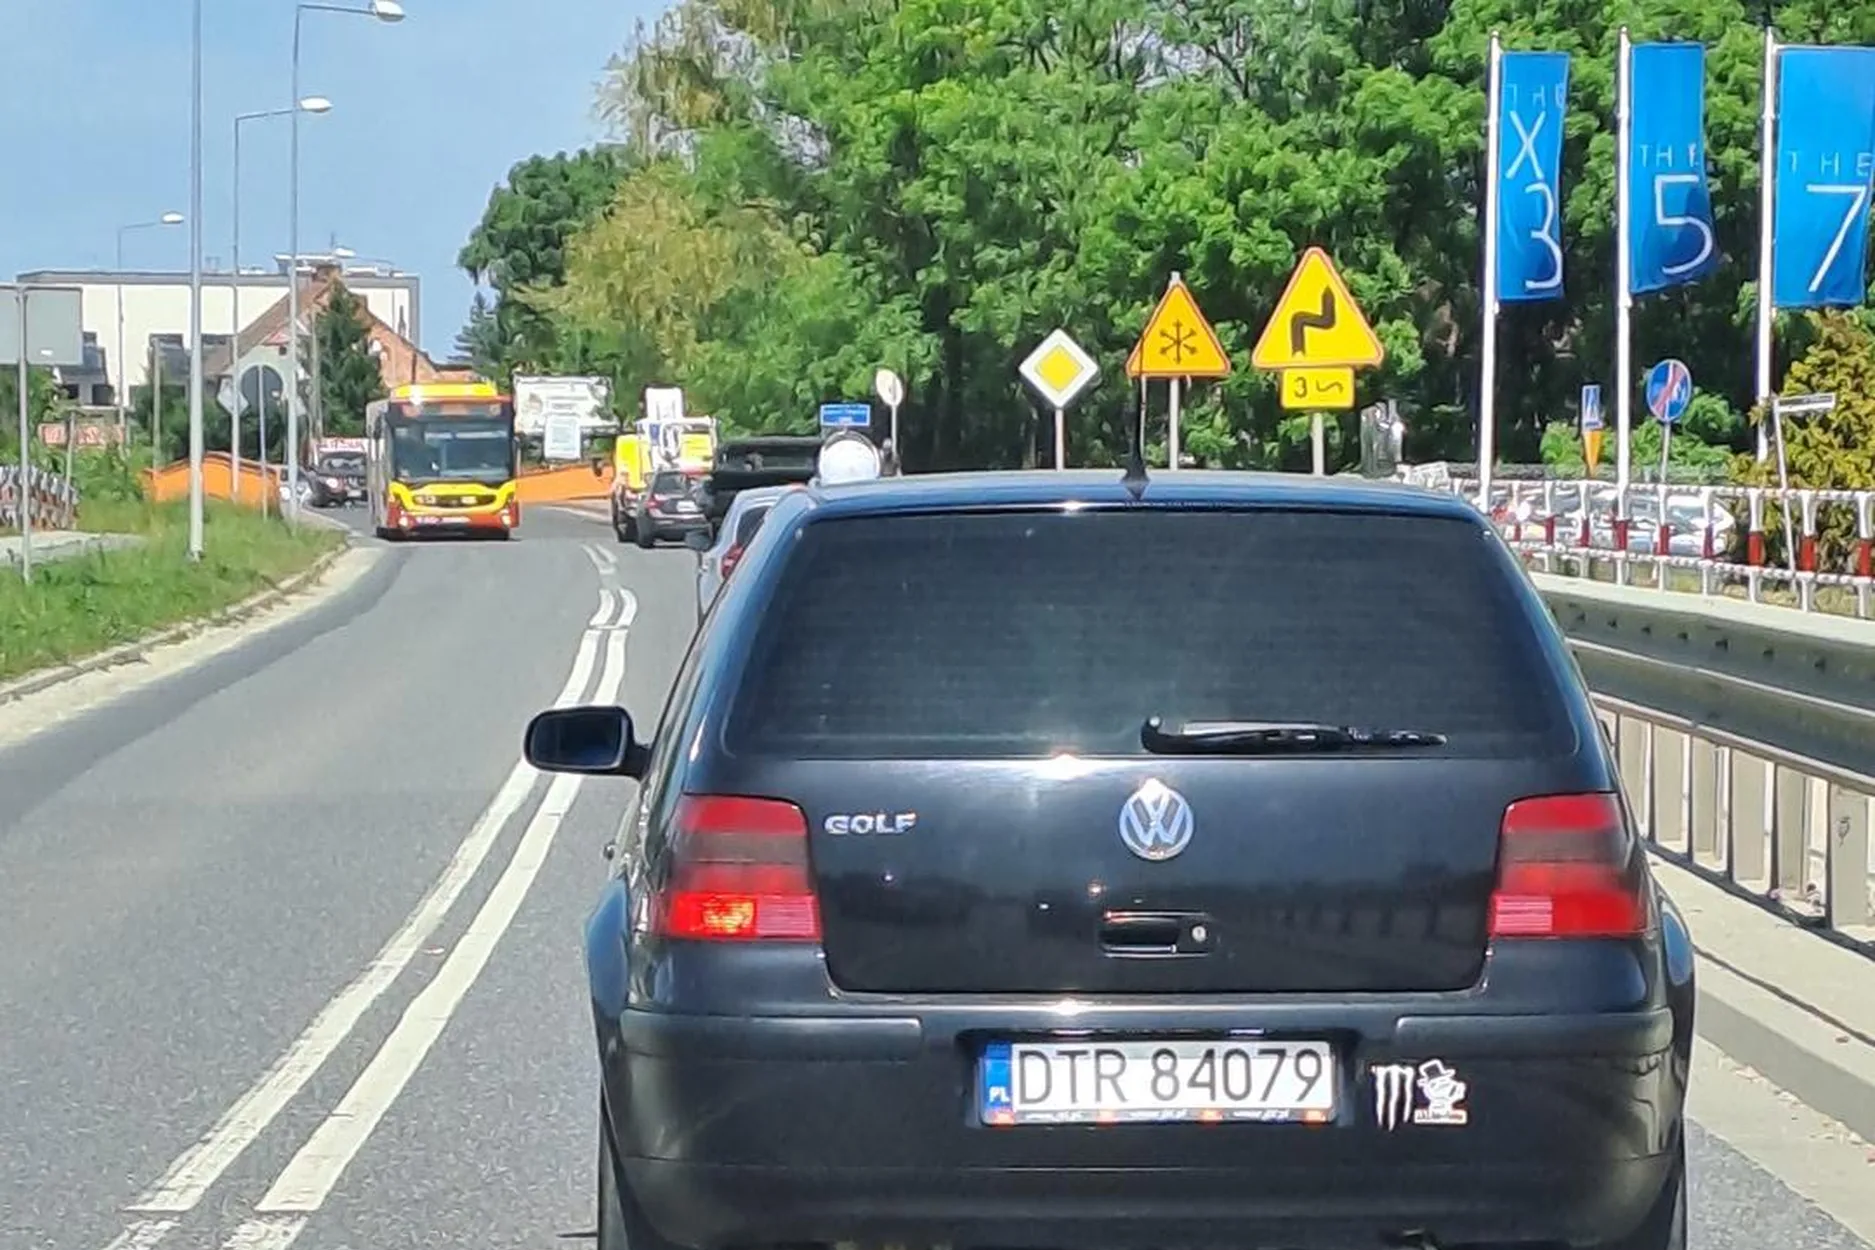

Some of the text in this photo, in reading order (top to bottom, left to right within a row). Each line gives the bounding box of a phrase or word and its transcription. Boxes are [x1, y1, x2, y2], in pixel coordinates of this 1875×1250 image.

[1640, 143, 1700, 168] THE
[1785, 150, 1875, 177] THE
[1654, 174, 1714, 275] 5
[1806, 184, 1869, 293] 7
[1292, 376, 1308, 398] 3
[823, 812, 917, 836] GOLF
[1017, 1047, 1326, 1106] DTR 84079
[988, 1086, 1011, 1104] PL
